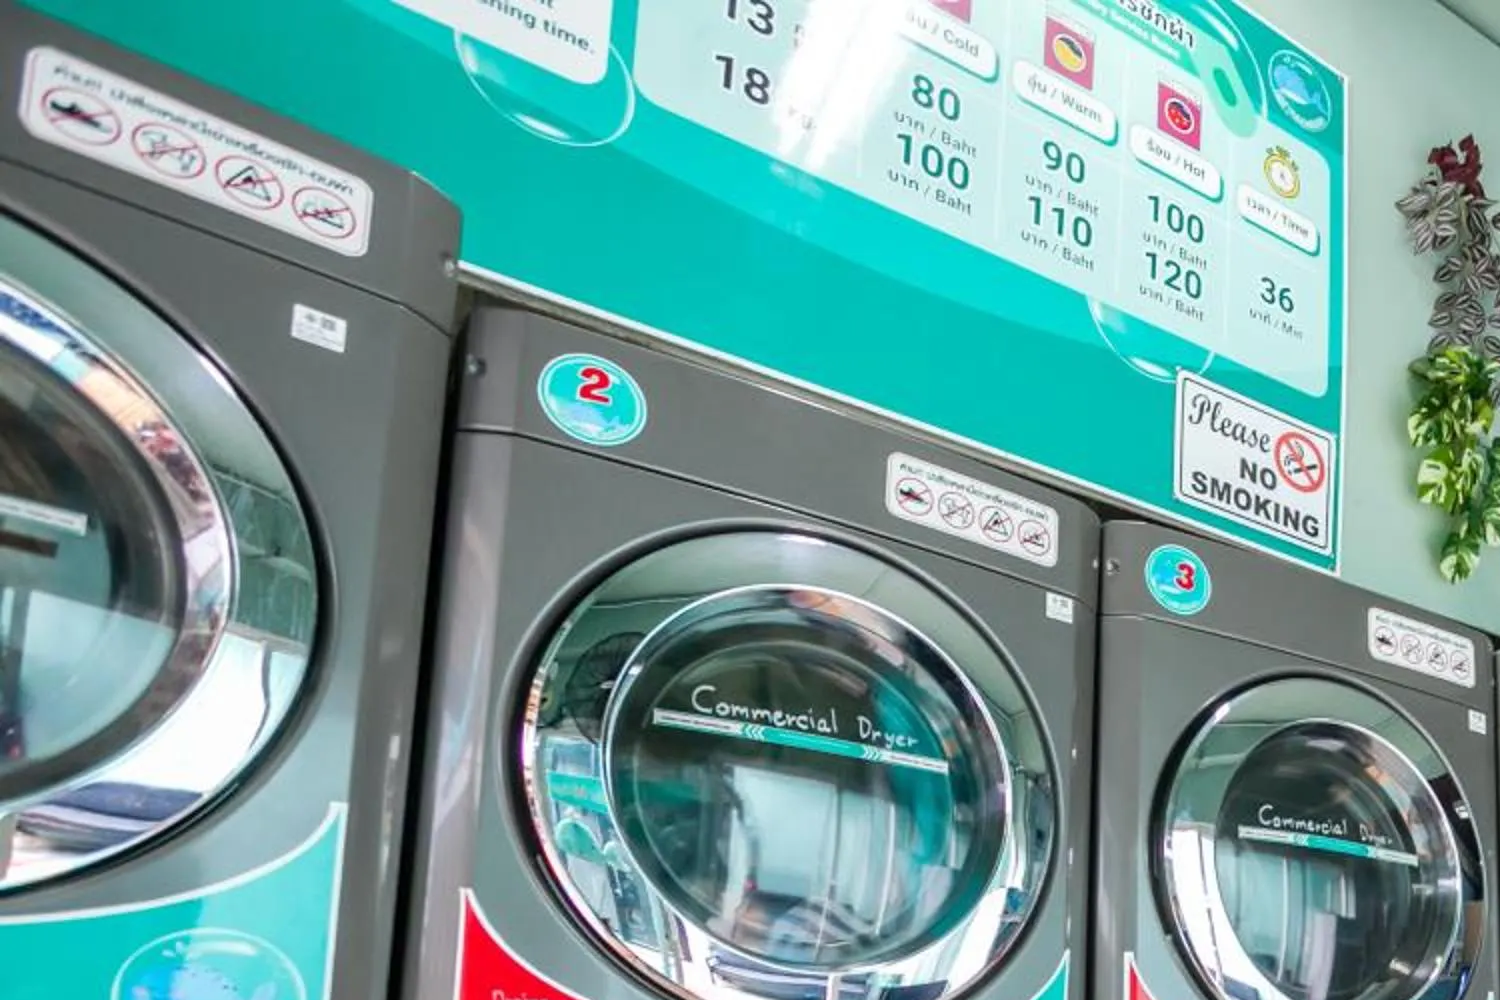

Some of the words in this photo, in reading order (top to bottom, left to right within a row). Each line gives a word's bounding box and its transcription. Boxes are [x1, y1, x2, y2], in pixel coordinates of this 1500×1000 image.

[724, 0, 775, 35] 13
[543, 19, 596, 54] time.
[943, 28, 980, 57] Cold
[715, 54, 771, 105] 18
[911, 73, 961, 122] 80
[1061, 88, 1103, 124] Warm
[940, 130, 977, 158] Baht
[896, 133, 970, 191] 100
[1042, 140, 1086, 184] 90
[1183, 155, 1206, 181] Hot
[935, 188, 973, 216] Baht
[1066, 191, 1099, 217] Baht
[1146, 195, 1205, 243] 100
[1027, 196, 1093, 248] 110
[1280, 211, 1310, 239] Time
[1062, 241, 1095, 271] Baht
[1179, 246, 1207, 270] Baht
[1145, 251, 1203, 300] 120
[1175, 298, 1205, 323] Baht
[1259, 276, 1295, 314] 36
[1281, 321, 1304, 340] Min
[577, 366, 611, 403] 2
[1188, 393, 1271, 453] Please
[1239, 457, 1278, 491] NO
[1190, 470, 1320, 538] SMOKING
[1174, 562, 1195, 591] 3
[691, 684, 839, 734] Commercial
[857, 714, 918, 749] Dryer
[1257, 803, 1349, 836] Commercial
